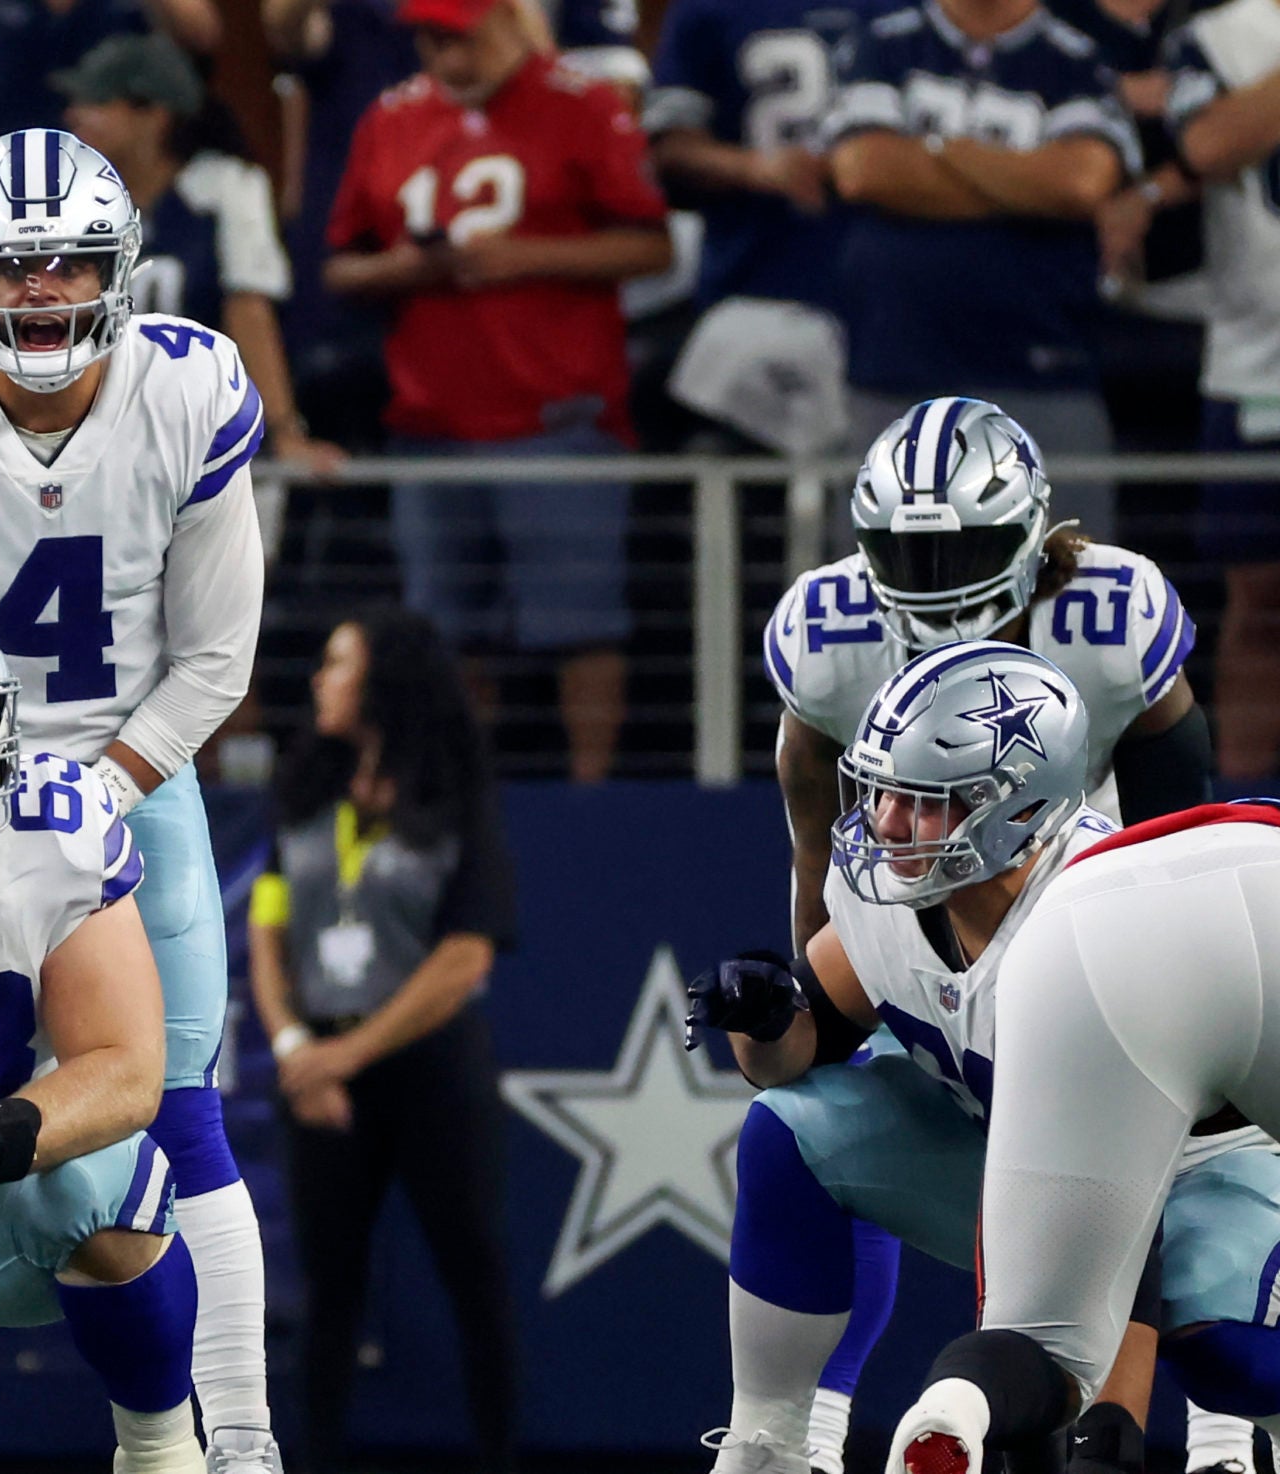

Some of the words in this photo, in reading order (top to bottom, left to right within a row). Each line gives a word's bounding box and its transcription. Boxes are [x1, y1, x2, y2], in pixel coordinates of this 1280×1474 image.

[396, 155, 526, 247] 12
[138, 322, 215, 360] 4
[805, 571, 884, 654] 21
[1051, 564, 1135, 647] 21
